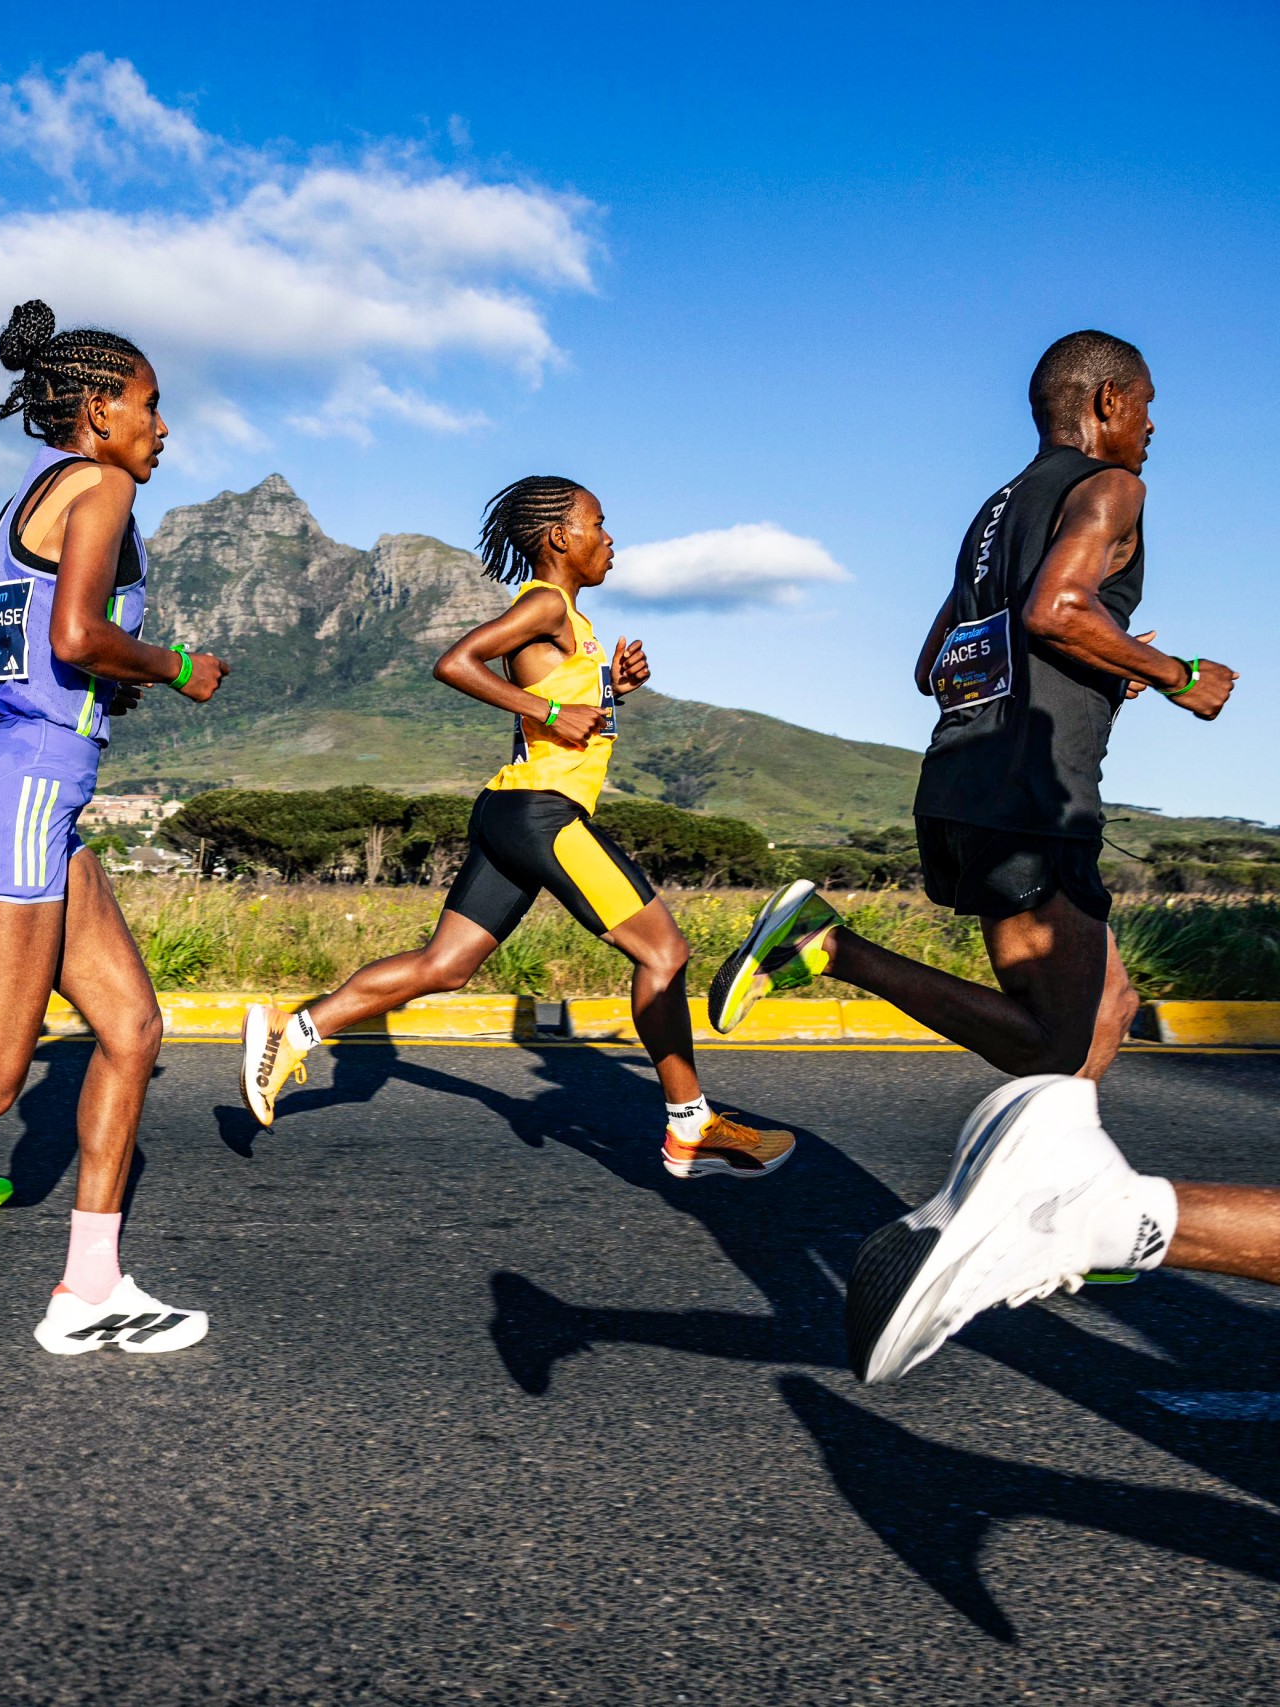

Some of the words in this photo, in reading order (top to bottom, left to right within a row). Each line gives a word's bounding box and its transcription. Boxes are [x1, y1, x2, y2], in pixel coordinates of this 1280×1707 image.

[974, 501, 1007, 584] PUMA
[942, 643, 977, 667] PACE
[980, 639, 991, 655] 5
[256, 1027, 285, 1087] NITRO
